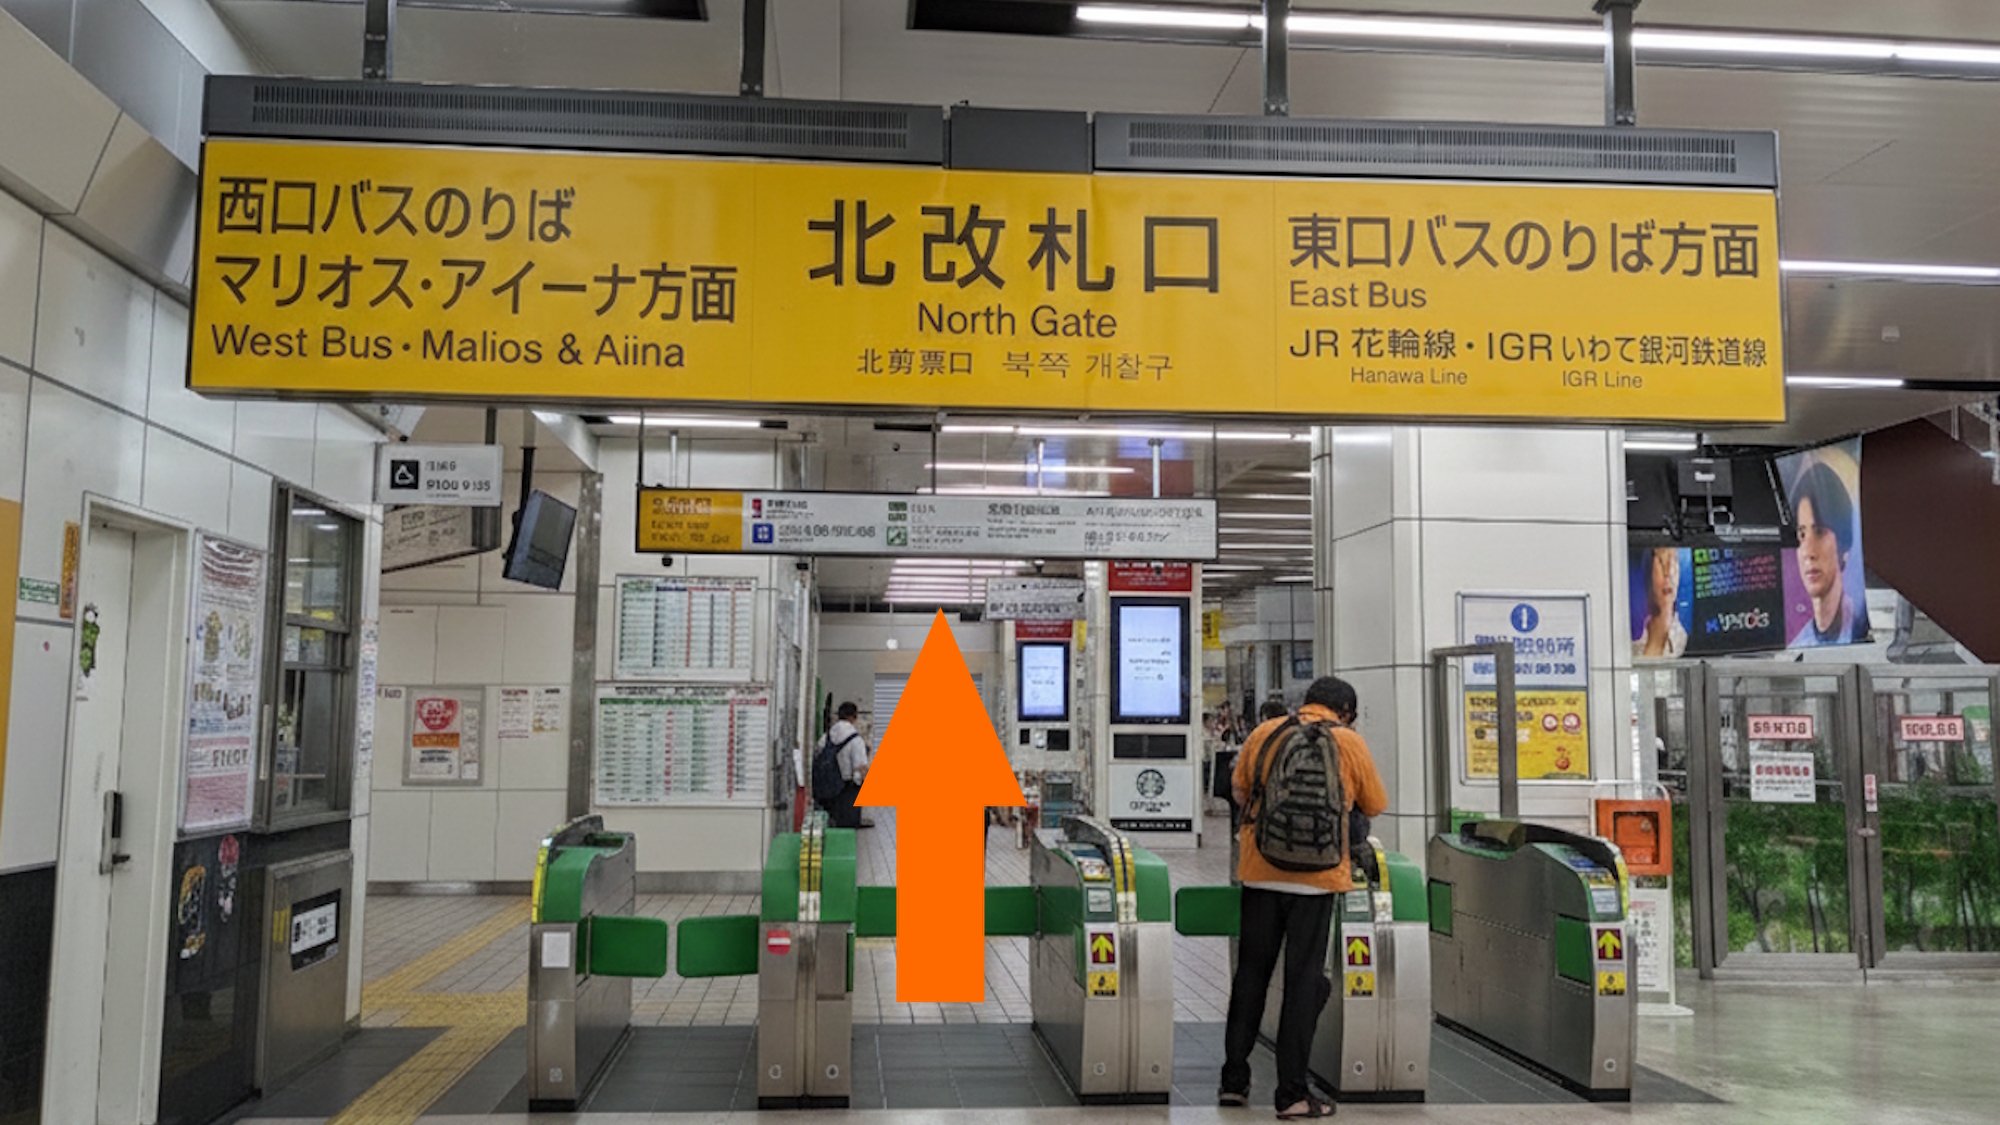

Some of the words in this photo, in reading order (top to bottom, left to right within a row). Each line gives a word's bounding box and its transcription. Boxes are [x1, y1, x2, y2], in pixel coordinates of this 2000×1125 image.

[218, 177, 575, 241] 西口バスのりば
[808, 199, 1218, 293] 北改札口
[1288, 213, 1758, 279] 東口バスのりば方面
[1290, 280, 1358, 307] East
[1369, 281, 1426, 308] Bus
[919, 302, 1015, 335] North
[1031, 305, 1116, 337] Gate
[212, 324, 307, 357] West
[558, 333, 583, 365] &
[594, 334, 684, 367] Aiina
[858, 348, 972, 375] 北剪票口
[1002, 350, 1070, 378] 북쪽
[1086, 353, 1173, 380] 개찰구
[1352, 367, 1424, 383] Hanawa
[1431, 368, 1467, 385] Line
[1563, 370, 1597, 387] IGR
[1605, 372, 1642, 388] Line
